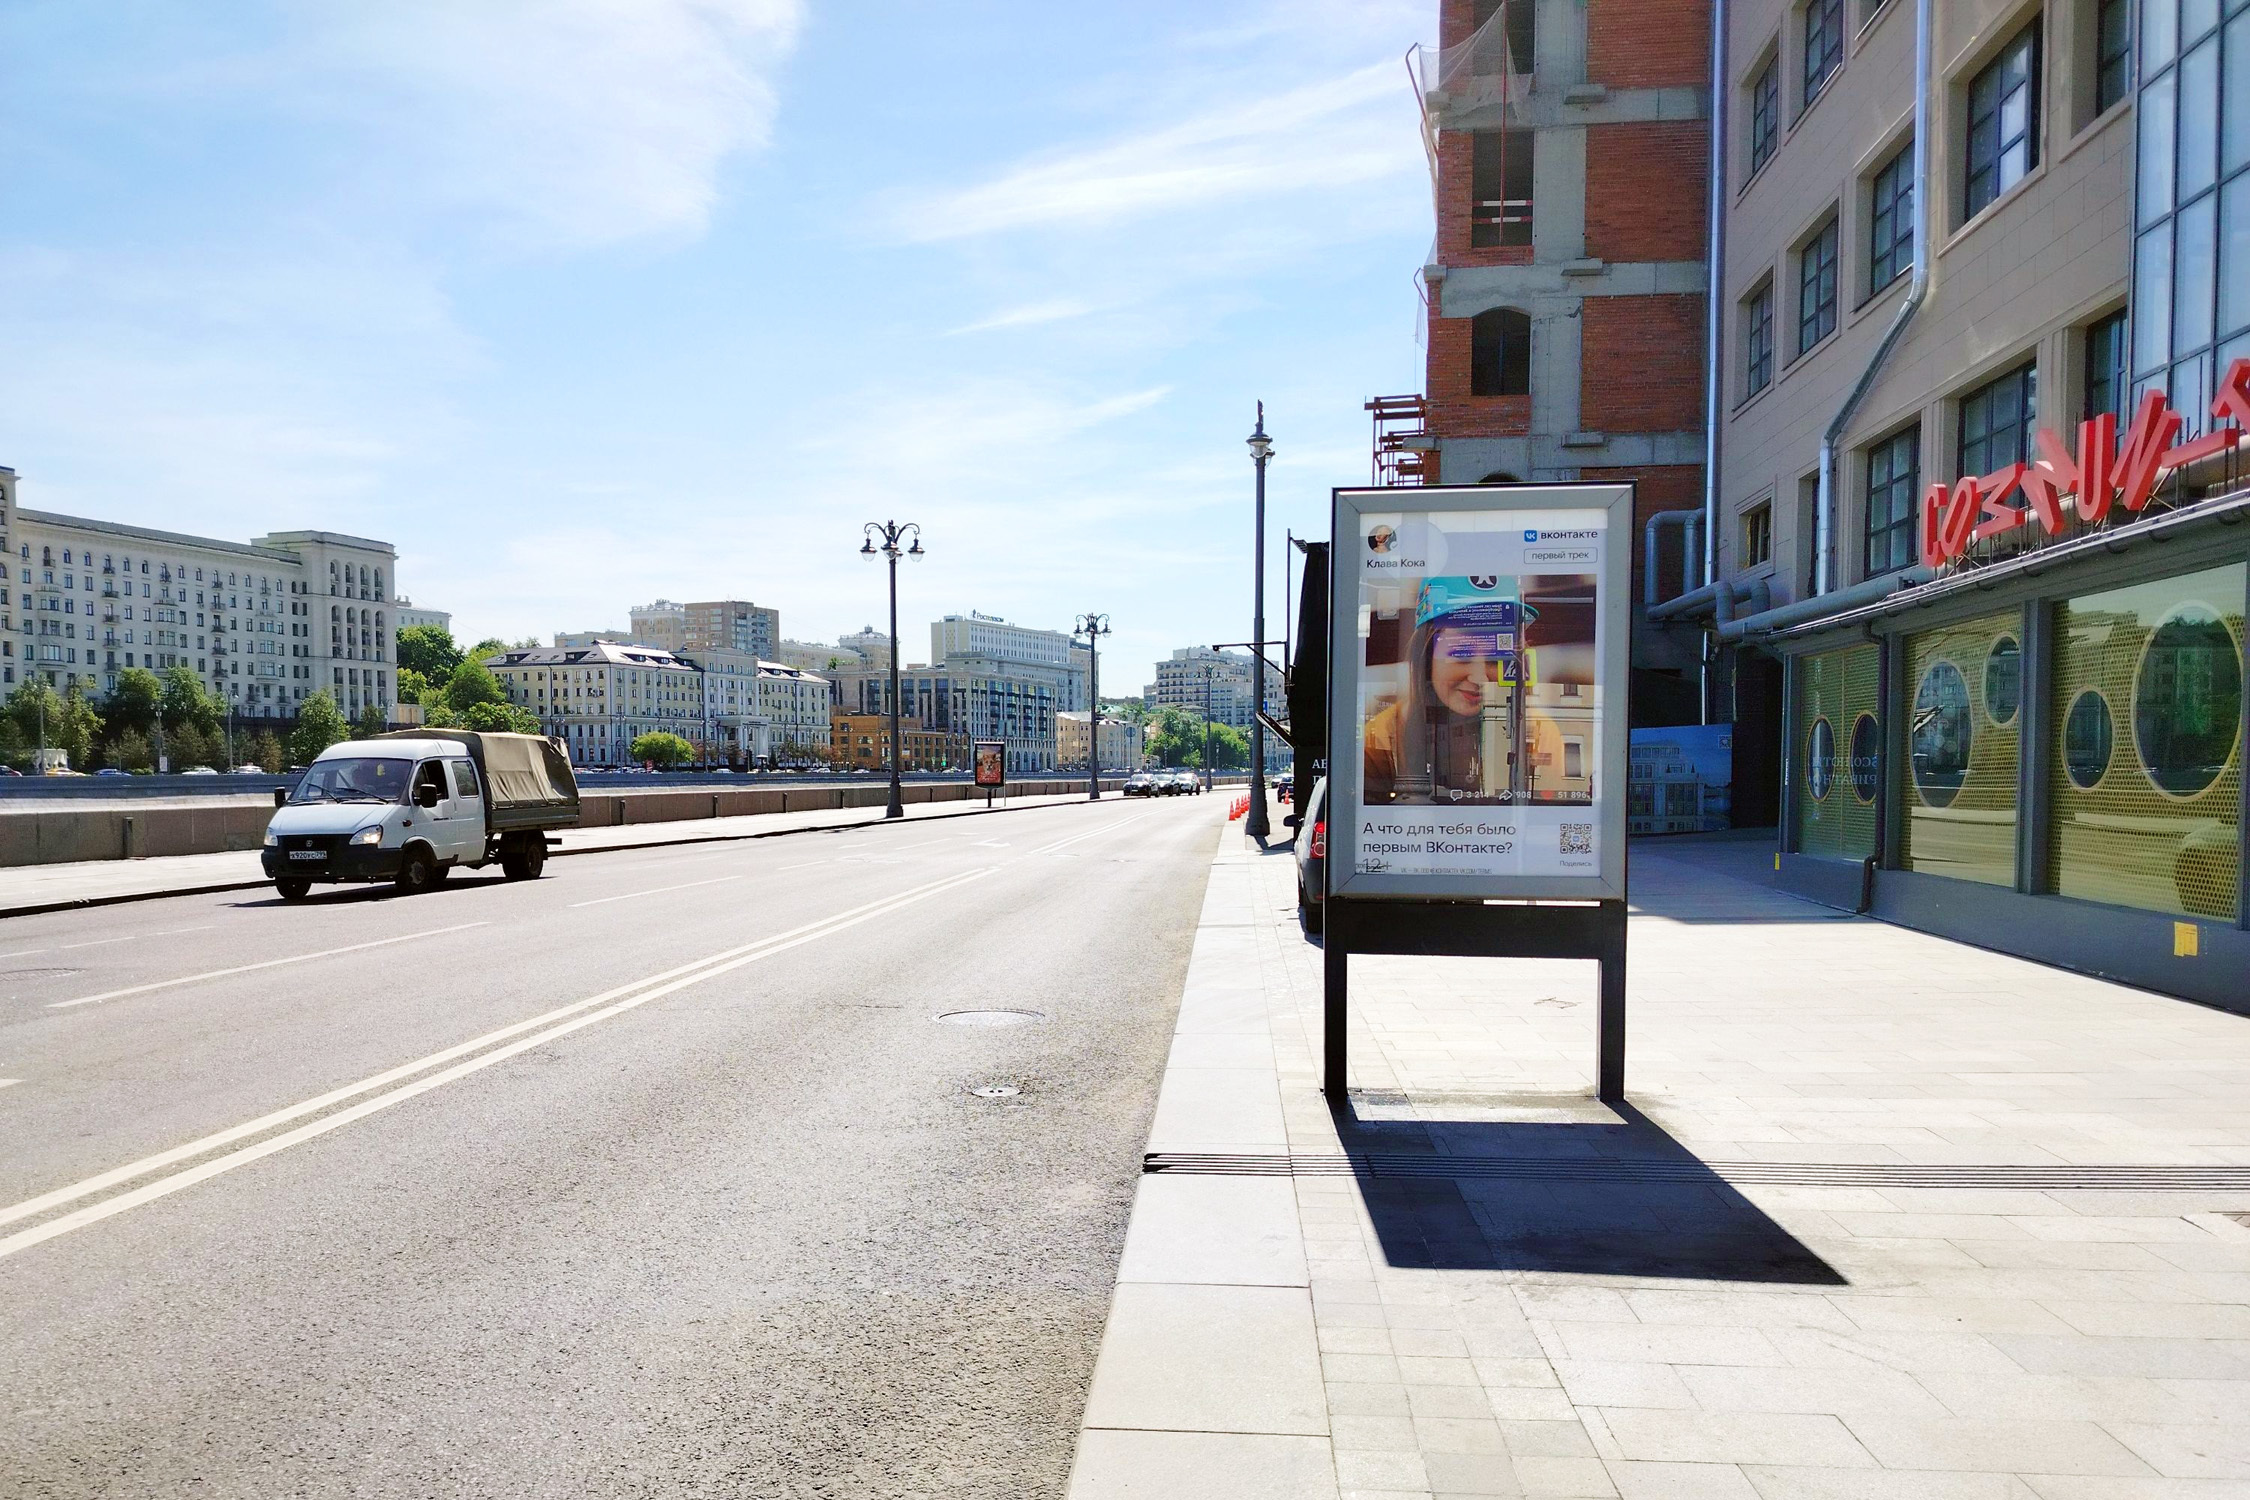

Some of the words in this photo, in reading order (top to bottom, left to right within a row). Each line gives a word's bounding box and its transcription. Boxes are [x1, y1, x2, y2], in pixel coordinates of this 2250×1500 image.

[1532, 551, 1566, 561] первый
[1569, 552, 1589, 560] трек
[1366, 559, 1398, 568] Клава
[1400, 558, 1426, 568] Кока
[1363, 822, 1374, 834] А
[1378, 825, 1403, 835] что
[1406, 825, 1434, 837] для
[1438, 823, 1473, 835] тебя
[1477, 823, 1517, 836] было
[1363, 842, 1422, 855] первым
[1426, 841, 1513, 854] ВКонтакте?
